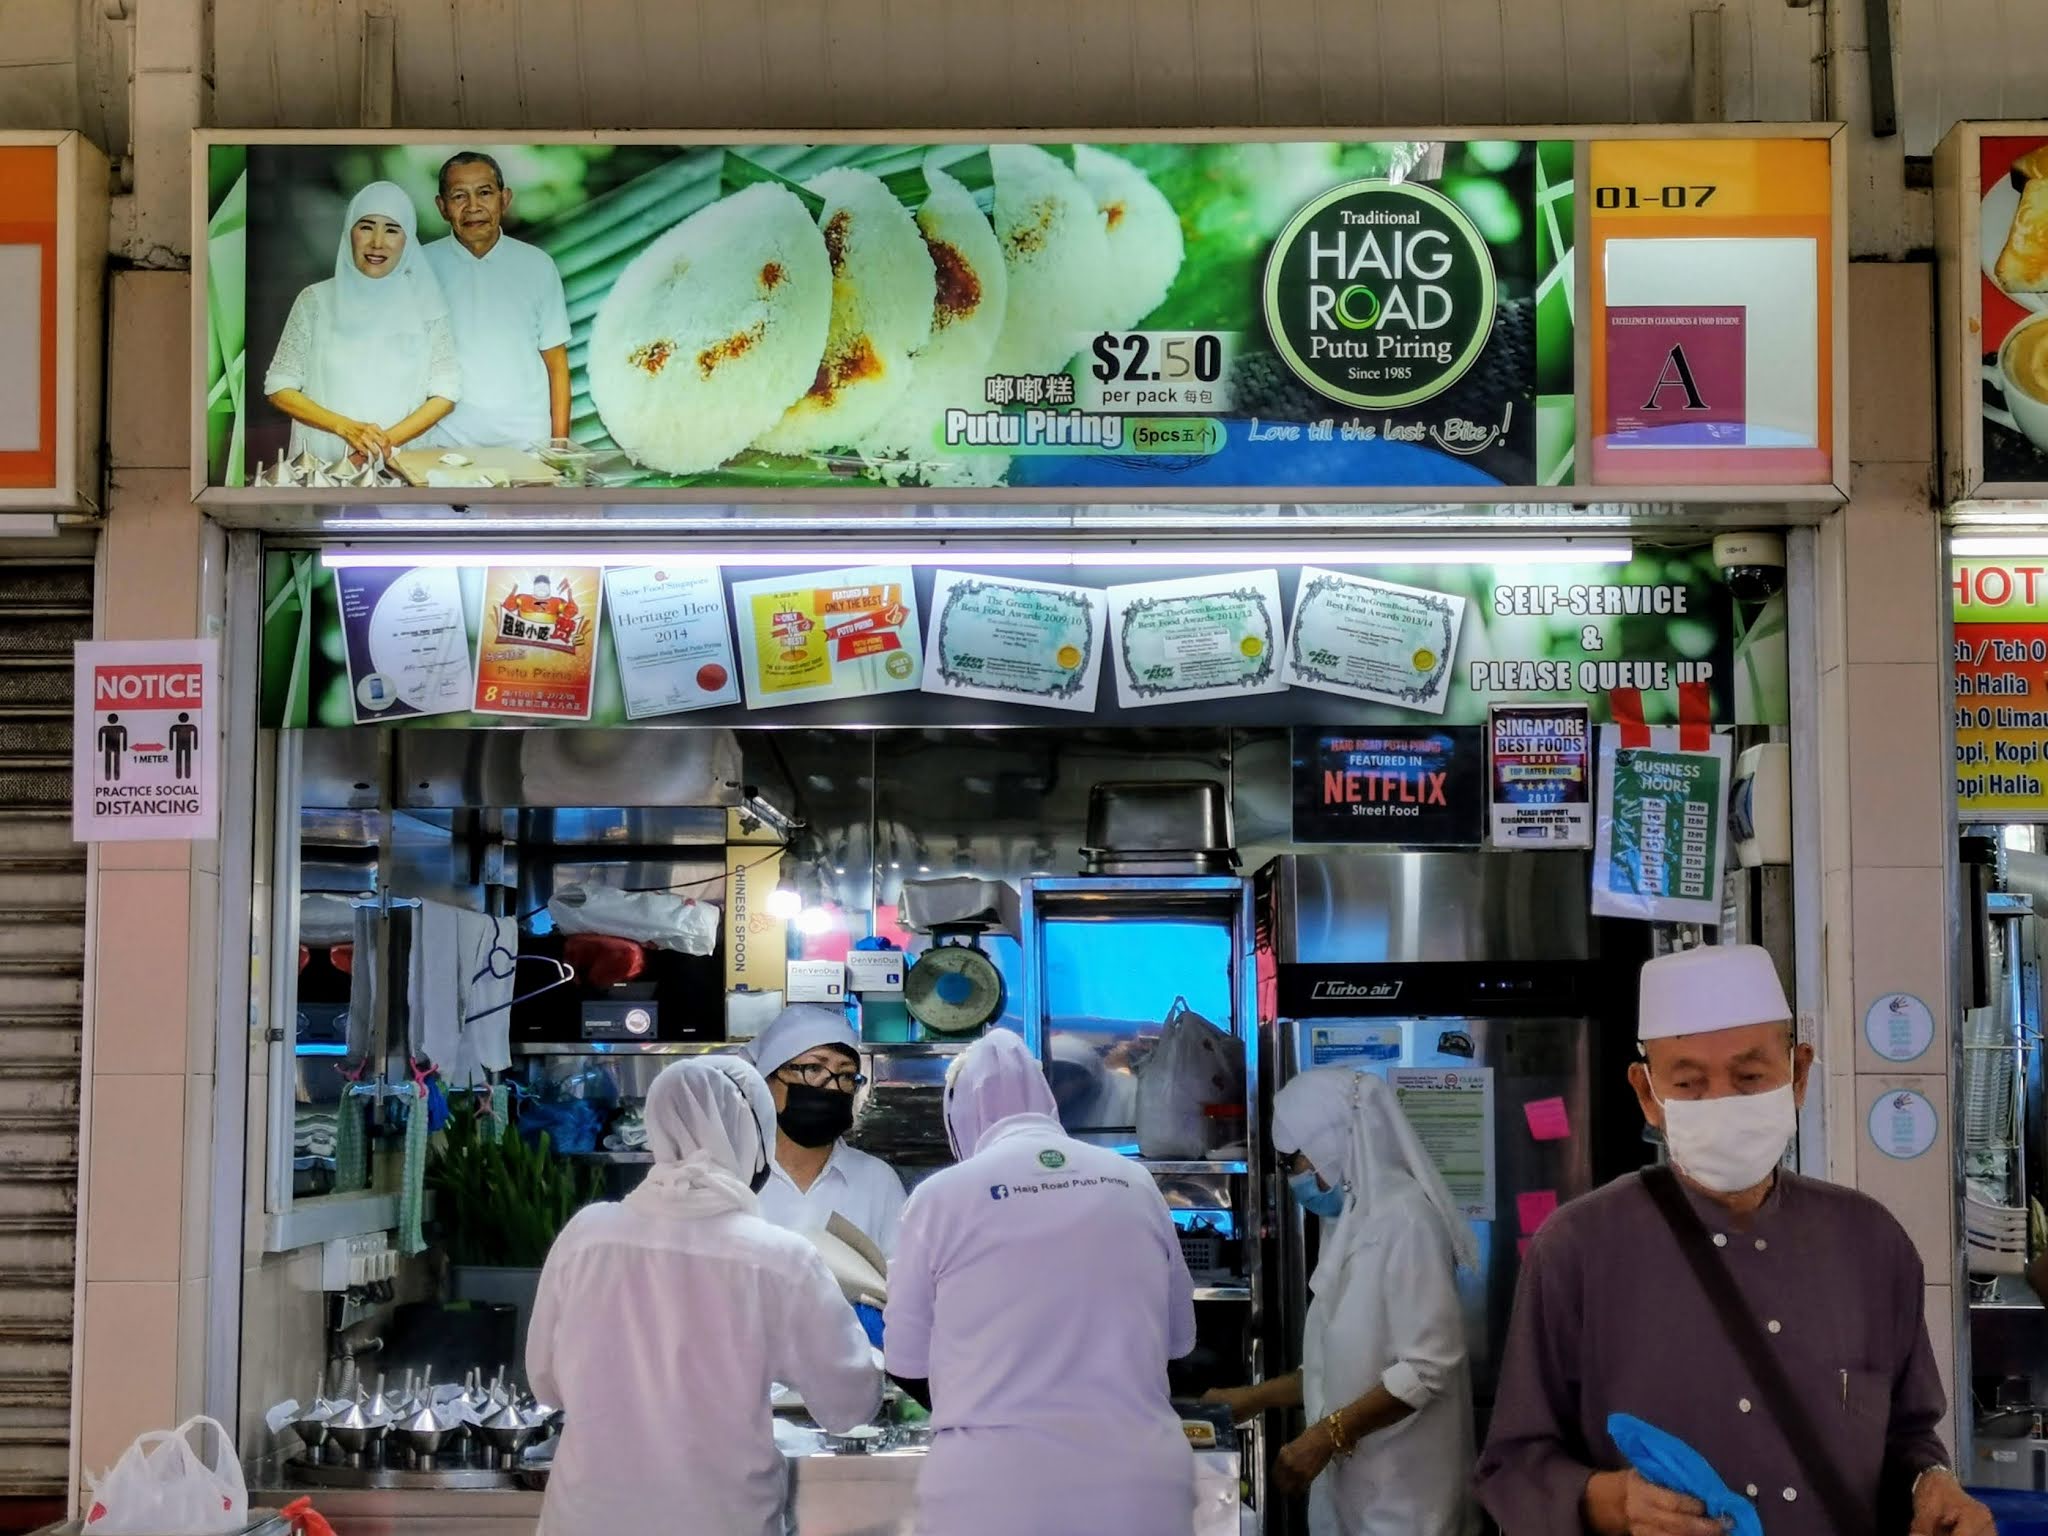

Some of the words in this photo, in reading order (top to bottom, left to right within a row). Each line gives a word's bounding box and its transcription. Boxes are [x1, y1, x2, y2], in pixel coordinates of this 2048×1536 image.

[1596, 185, 1717, 209] 01-07
[1340, 210, 1421, 226] Traditional
[1309, 229, 1453, 280] HAIG
[1309, 284, 1453, 330] ROAD
[1091, 331, 1221, 385] $2.50
[1309, 336, 1368, 359] Putu
[1376, 334, 1453, 364] Piring
[1347, 366, 1381, 380] Since
[1384, 366, 1413, 380] 1985
[1640, 343, 1711, 411] A
[986, 376, 1076, 405] 嘟嘟糕
[1102, 388, 1131, 405] per
[1136, 385, 1178, 404] pack
[1184, 388, 1214, 404] 每包
[945, 410, 1020, 446] Putu
[1025, 408, 1124, 449] Piring
[1247, 416, 1301, 442] Love
[1307, 419, 1335, 442] till
[1341, 417, 1377, 441] the
[1383, 419, 1426, 442] last
[825, 600, 846, 613] ONLY
[846, 598, 863, 610] THE
[987, 595, 1003, 606] The
[1005, 597, 1034, 610] Green
[1036, 601, 1059, 613] Book
[1494, 585, 1687, 615] SELF-SERVICE
[618, 607, 680, 627] Heritage
[684, 601, 719, 618] Hero
[961, 602, 980, 614] Best
[982, 605, 1007, 616] Food
[1008, 608, 1042, 621] Awards
[1138, 620, 1157, 630] Best
[1158, 618, 1180, 629] Food
[1182, 613, 1217, 626] Awards
[1216, 609, 1253, 621] 2011/12
[1326, 600, 1344, 611] Best
[1345, 603, 1367, 615] Food
[1368, 607, 1400, 622] Awards
[1401, 613, 1434, 628] 2013/14
[654, 628, 689, 644] 2014
[1580, 624, 1603, 651] &
[1309, 650, 1341, 661] GREEN
[1974, 640, 1988, 666] /
[1992, 640, 2027, 662] Teh
[498, 665, 528, 680] Putu
[1471, 661, 1571, 691] PLEASE
[1578, 661, 1669, 694] QUEUE
[97, 674, 201, 700] NOTICE
[485, 686, 498, 702] 8
[1977, 673, 2028, 695] Halia
[1495, 718, 1584, 737] SINGAPORE
[1498, 738, 1536, 754] BEST
[1537, 737, 1582, 753] FOODS
[1994, 741, 2038, 766] Kopi
[133, 755, 138, 764] 1
[138, 755, 170, 764] METER
[1349, 755, 1406, 767] FEATURED
[1409, 755, 1422, 767] IN
[1521, 755, 1559, 764] ENJOY
[1633, 760, 1701, 779] BUSINESS
[95, 786, 153, 799] PRACTICE
[155, 785, 199, 798] SOCIAL
[1323, 770, 1447, 806] NETFLIX
[1642, 777, 1691, 795] HOURS
[1989, 773, 2041, 796] Halia
[96, 799, 200, 816] DISTANCING
[1528, 793, 1557, 803] 2017
[1352, 804, 1387, 816] Street
[1388, 804, 1420, 817] Food
[734, 864, 746, 921] CHINESE
[734, 921, 746, 973] SPOON
[1325, 980, 1368, 996] Turbo
[1370, 983, 1393, 997] air
[1013, 1185, 1039, 1195] Haig
[1041, 1181, 1069, 1192] Road
[1072, 1179, 1098, 1190] Putu
